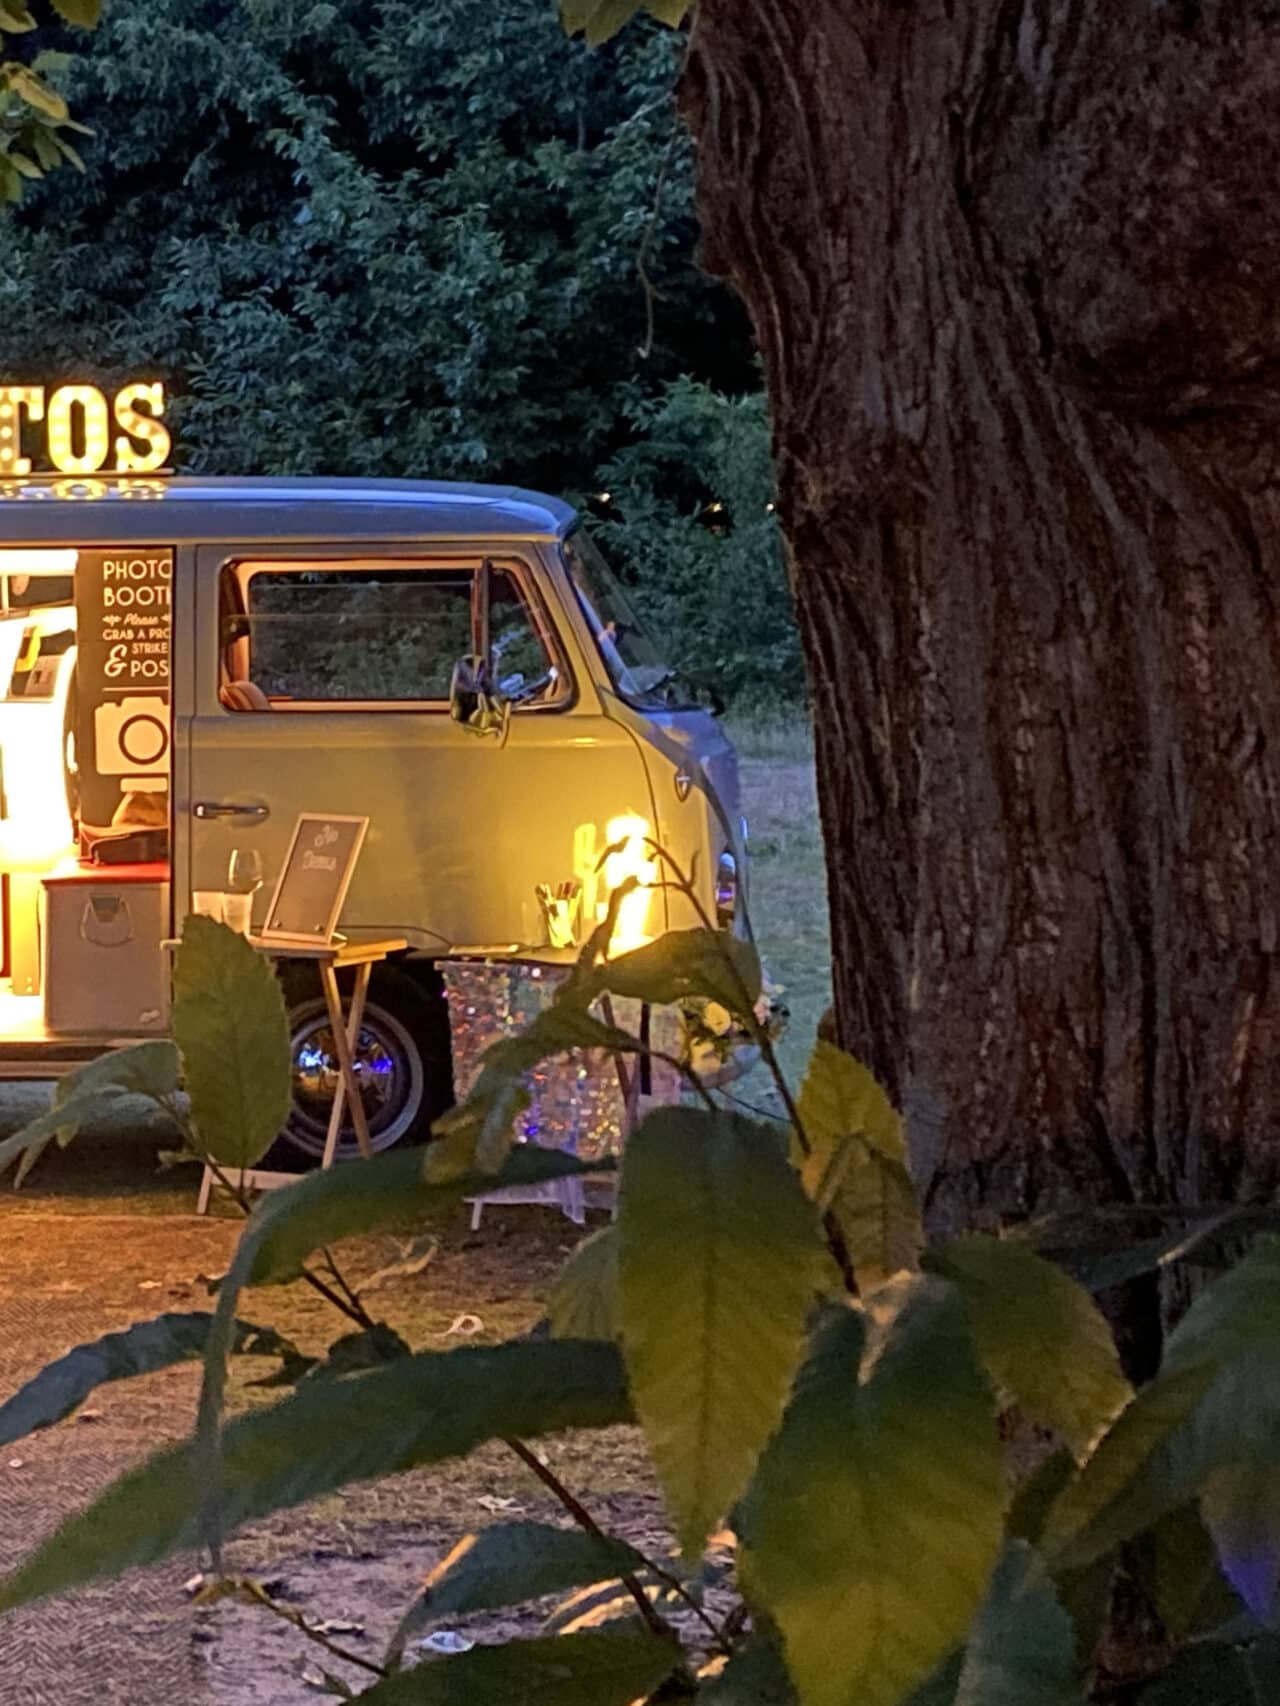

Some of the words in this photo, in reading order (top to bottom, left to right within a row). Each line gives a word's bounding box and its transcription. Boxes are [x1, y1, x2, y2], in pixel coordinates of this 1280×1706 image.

[103, 559, 172, 580] PHOTO
[102, 628, 134, 640] GRAB
[137, 628, 146, 639] A
[104, 644, 127, 677] &
[132, 642, 169, 654] STRIKE
[130, 660, 169, 677] POS
